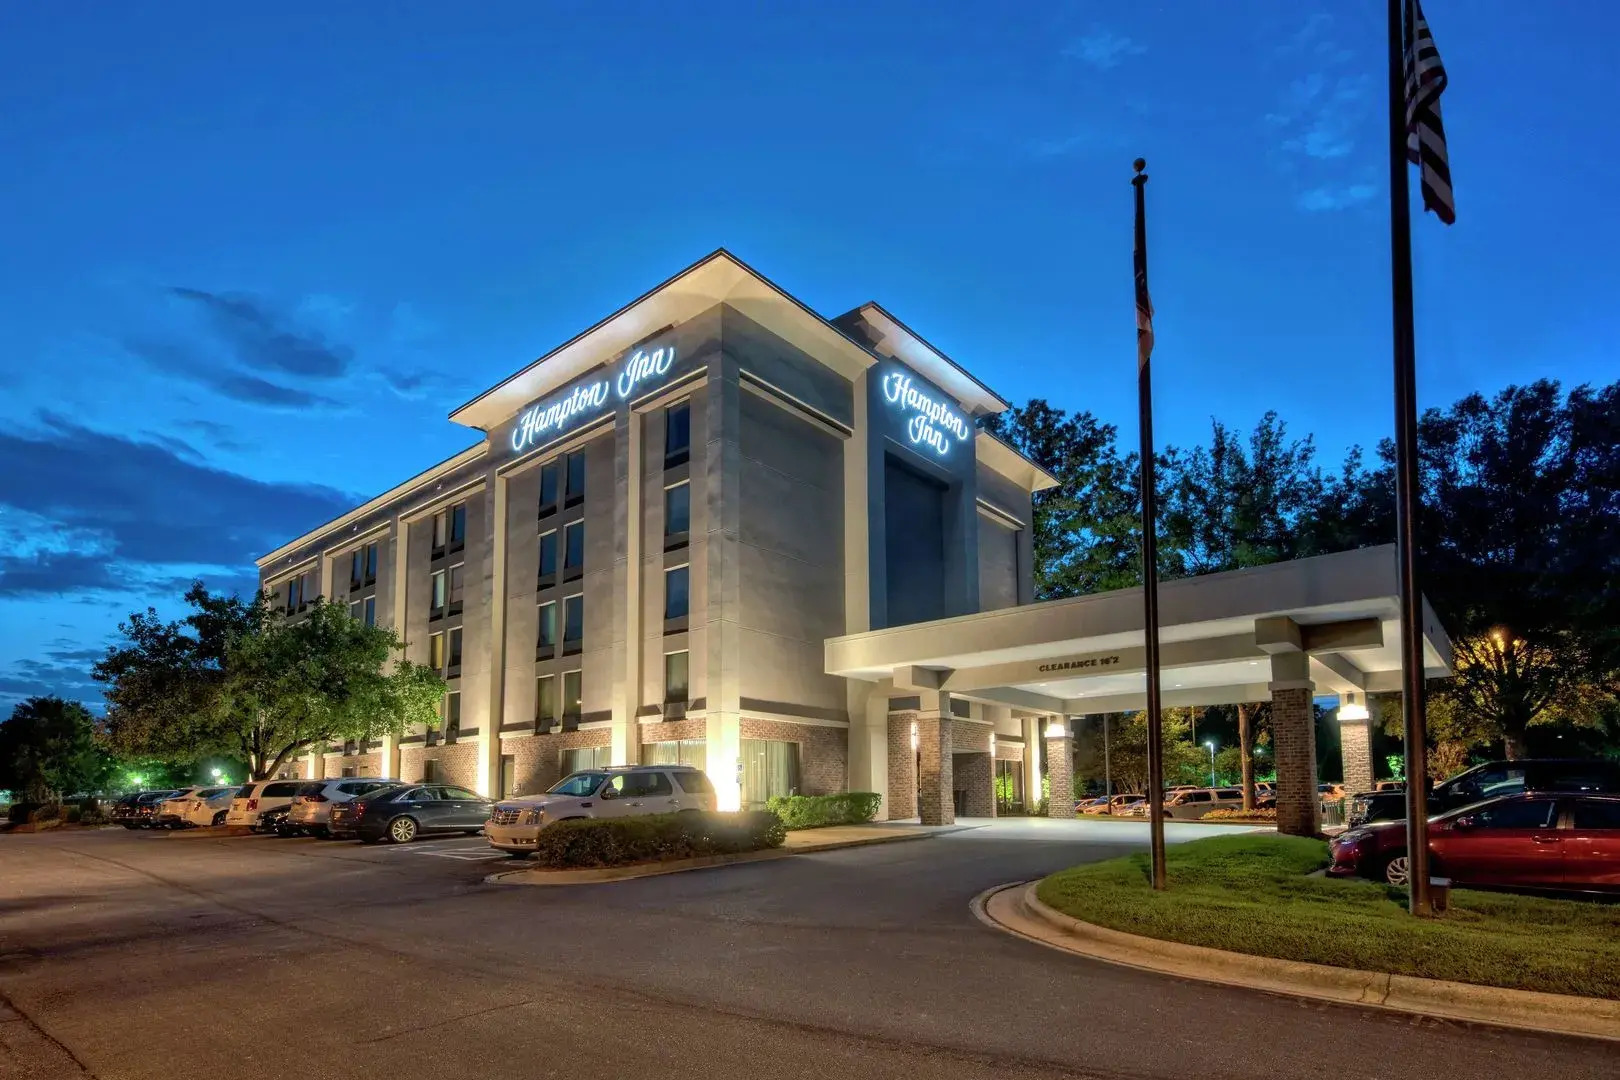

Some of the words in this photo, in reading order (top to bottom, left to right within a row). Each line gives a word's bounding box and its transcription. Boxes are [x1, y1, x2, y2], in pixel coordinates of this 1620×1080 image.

[512, 381, 609, 451] Hampton
[617, 347, 674, 398] Inn
[883, 372, 968, 441] Hampton
[908, 415, 948, 455] Inn
[1039, 659, 1097, 672] CLEARANCE
